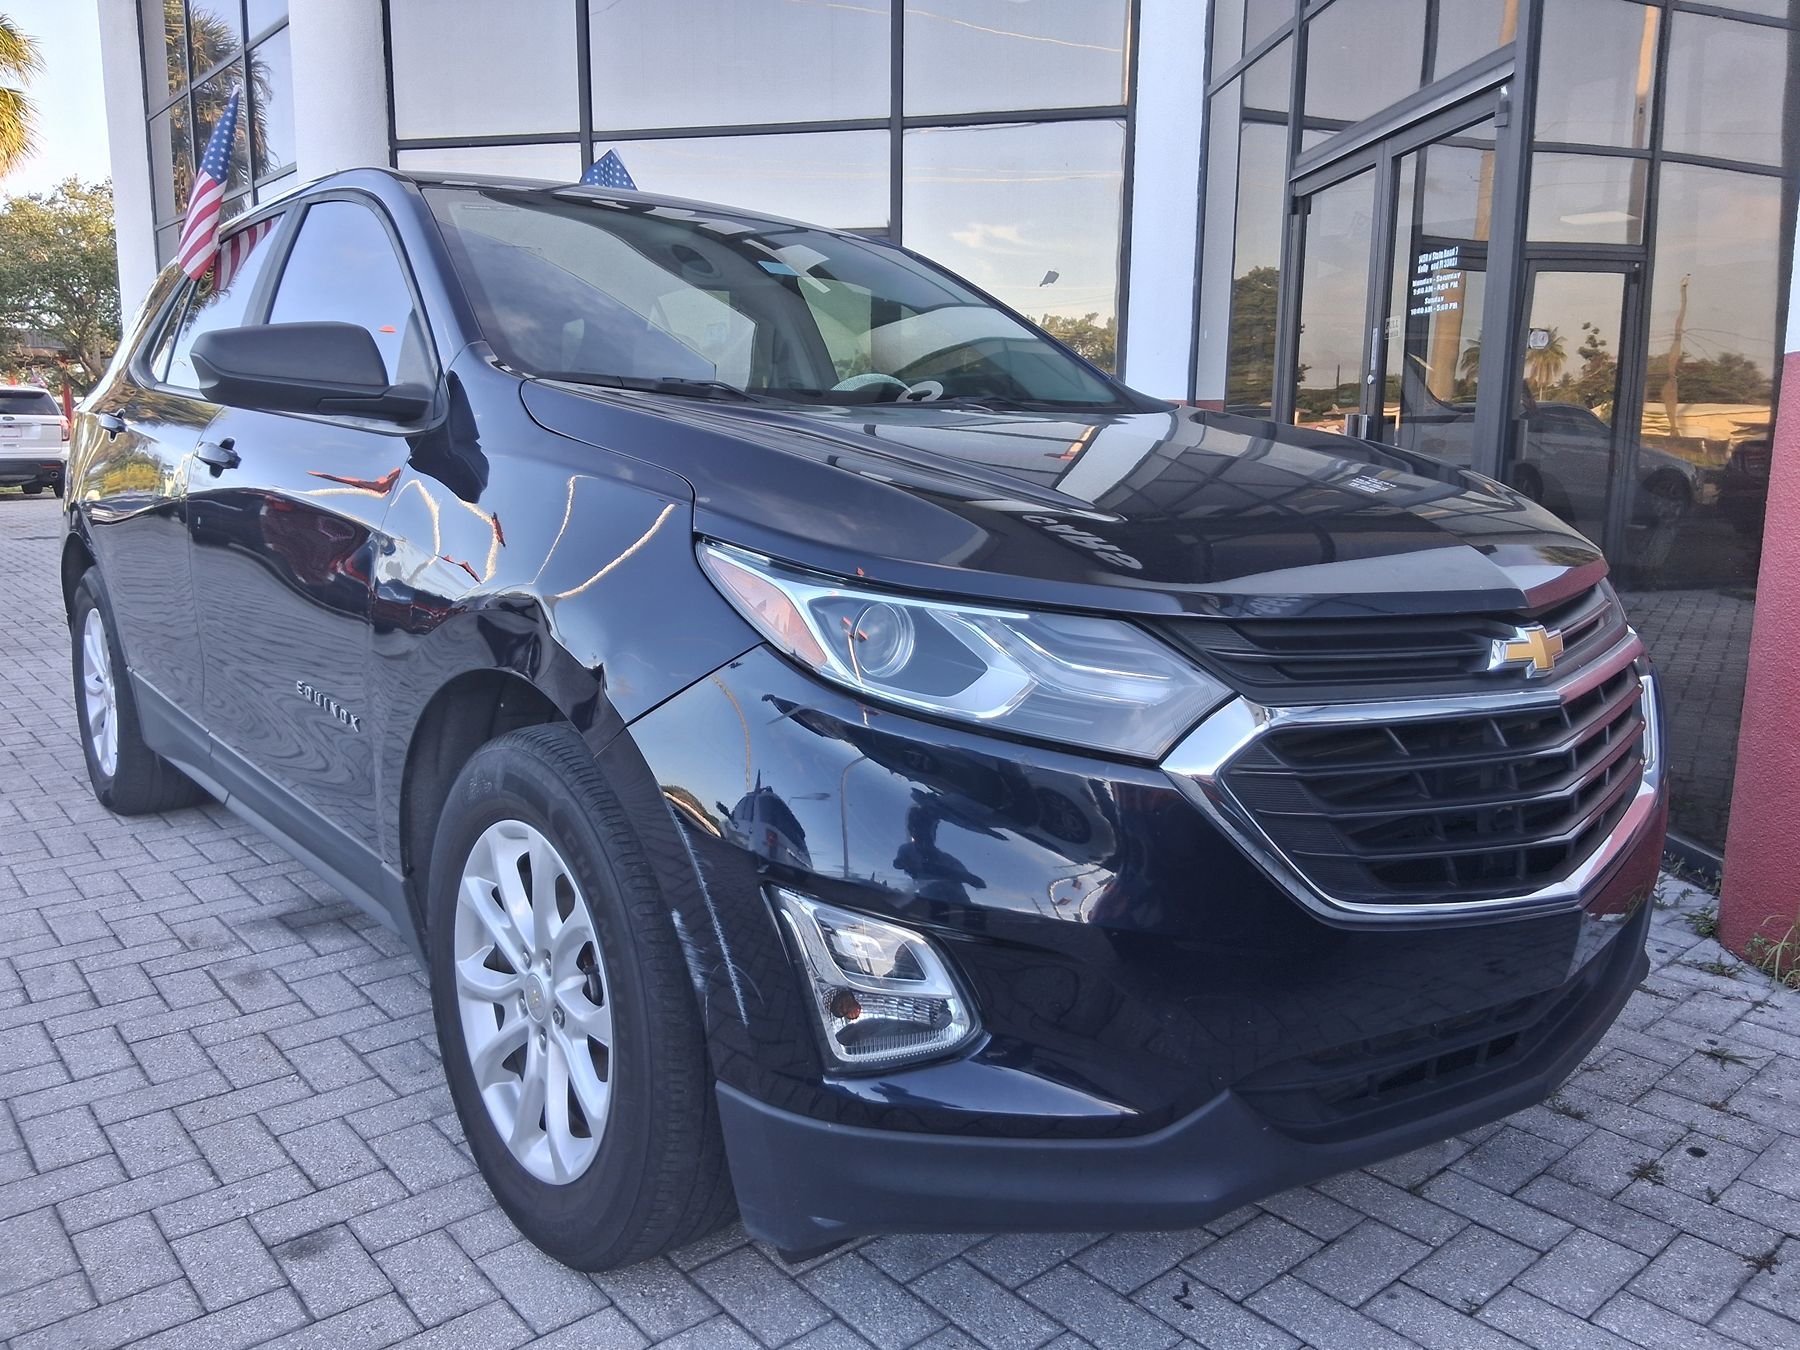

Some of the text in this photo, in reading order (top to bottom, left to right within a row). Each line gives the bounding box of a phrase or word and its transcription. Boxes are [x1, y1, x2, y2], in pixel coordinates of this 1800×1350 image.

[1412, 278, 1432, 287] Monday
[1436, 272, 1461, 282] Saturday
[1424, 296, 1444, 304] Sunday
[296, 680, 360, 732] EQUINOX
